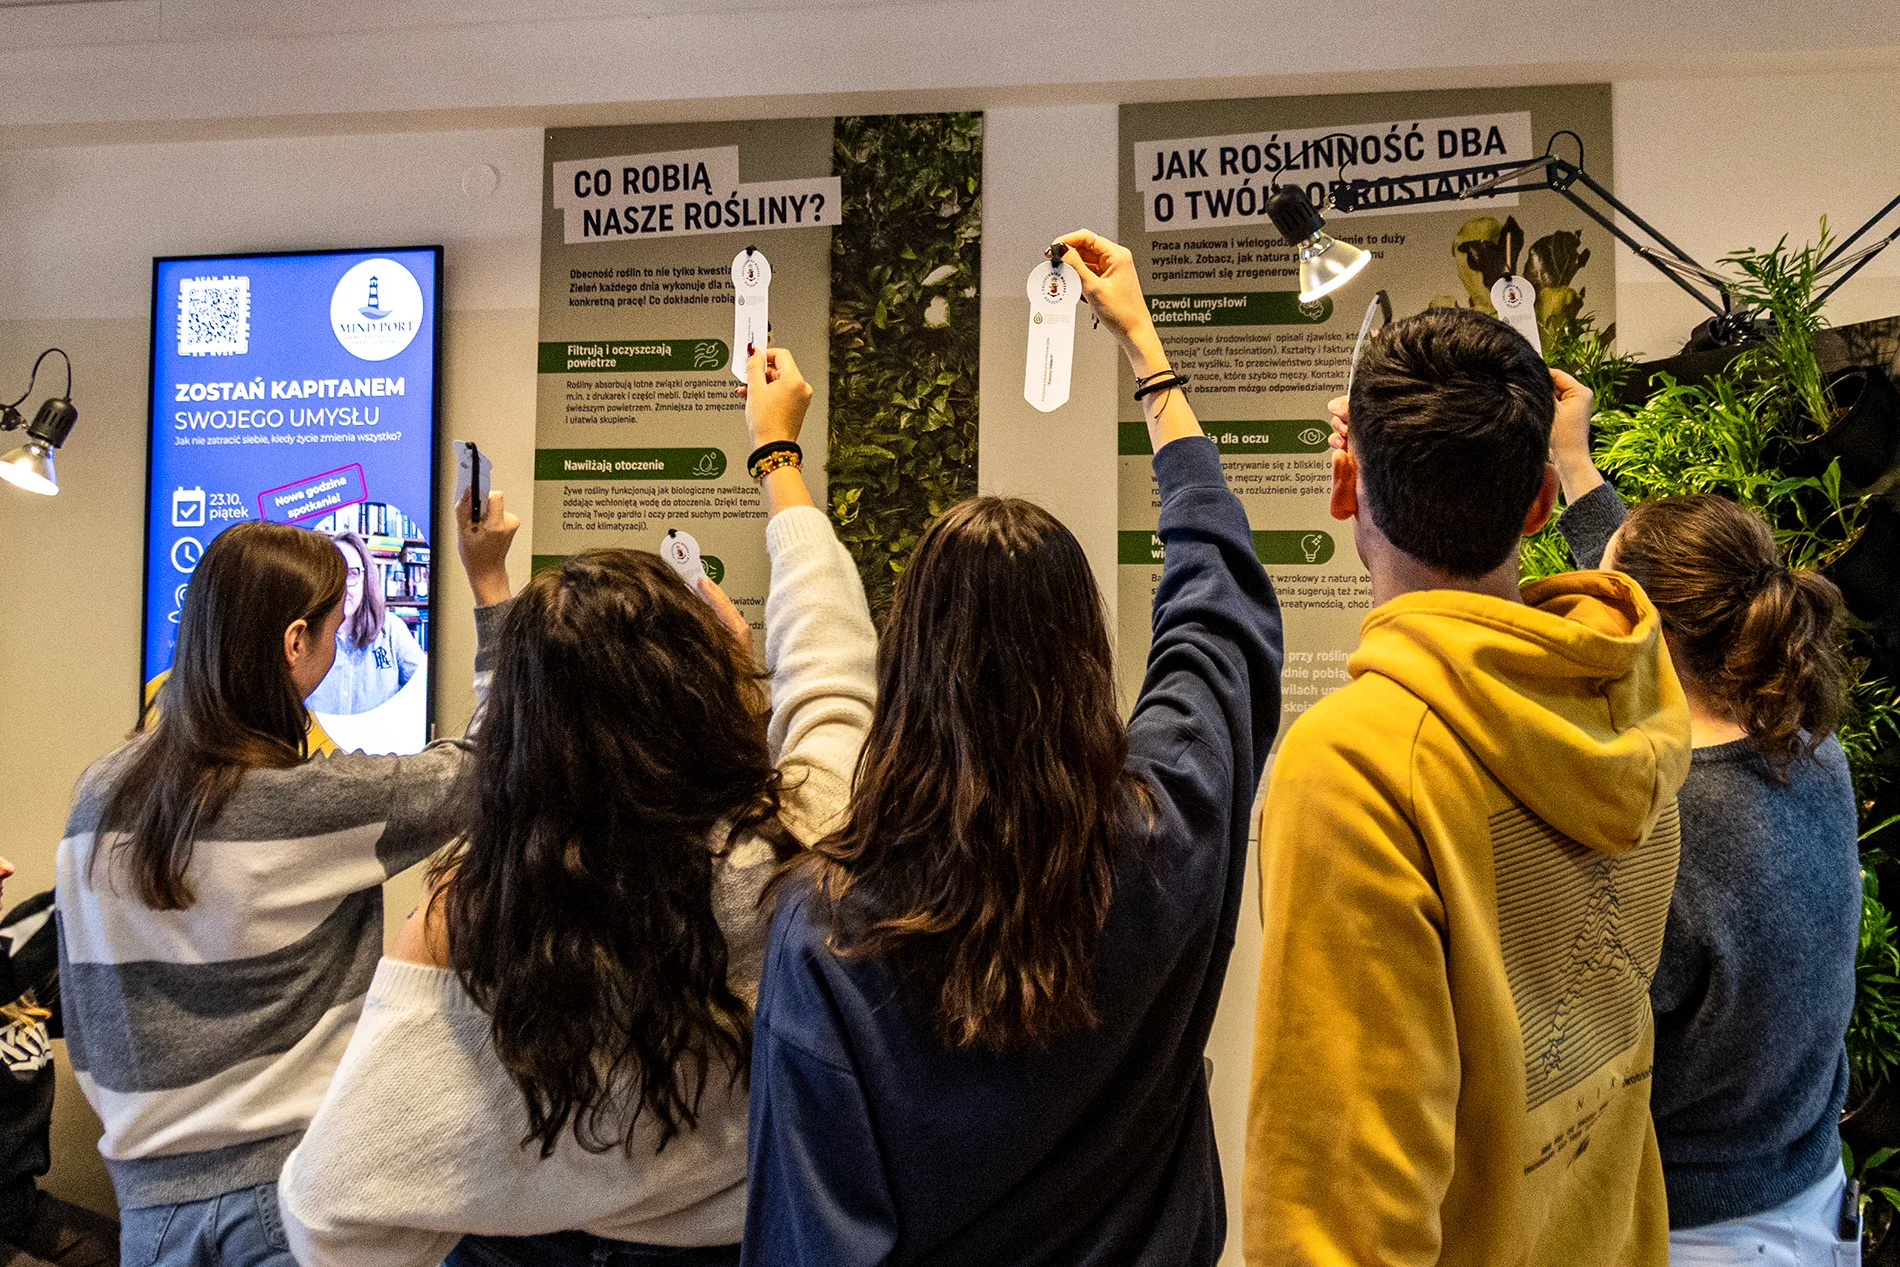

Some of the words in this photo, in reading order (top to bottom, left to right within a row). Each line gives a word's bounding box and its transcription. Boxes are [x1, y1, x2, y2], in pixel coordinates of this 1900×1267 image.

[1151, 150, 1209, 181] JAK
[1220, 123, 1425, 176] ROŚLINNOŚĆ
[1437, 126, 1507, 159] DBA
[574, 170, 611, 198] CO
[623, 162, 712, 195] ROBIĄ
[1154, 193, 1174, 222] O
[1185, 181, 1270, 220] TWÓJ
[583, 205, 673, 236] NASZE
[685, 191, 825, 230] ROŚLINY?
[1152, 241, 1180, 251] Praca
[1183, 241, 1227, 249] naukowa
[1231, 239, 1234, 248] i
[1367, 235, 1377, 244] to
[1381, 234, 1405, 246] duży
[1152, 255, 1192, 265] wysiłek.
[1196, 254, 1234, 265] Zobacz,
[1237, 253, 1253, 263] jak
[1256, 254, 1289, 262] natura
[570, 269, 614, 279] Obecność
[616, 268, 640, 277] roślin
[644, 269, 653, 277] to
[656, 268, 669, 276] nie
[673, 267, 695, 278] tylko
[1152, 269, 1215, 280] organizmowi
[1218, 268, 1233, 279] się
[1236, 268, 1300, 277] zregenerowa
[570, 283, 597, 292] Zieleń
[600, 283, 636, 292] każdego
[640, 283, 659, 291] dnia
[662, 281, 705, 292] wykonuje
[708, 280, 722, 289] dla
[569, 298, 615, 307] konkretną
[618, 296, 646, 307] pracę!
[649, 296, 660, 304] Co
[663, 295, 708, 303] dokładnie
[1151, 298, 1190, 309] Pozwól
[1194, 297, 1247, 308] umysłowi
[1151, 311, 1211, 323] odetchnąć
[340, 323, 376, 333] MIND
[380, 321, 414, 331] PORT
[1215, 334, 1271, 344] środowiskowi
[1276, 334, 1304, 343] opisali
[1306, 333, 1344, 343] zjawisko,
[568, 345, 603, 357] Filtrują
[606, 345, 610, 355] i
[612, 344, 671, 356] oczyszczają
[1203, 345, 1224, 357] (soft
[1226, 345, 1279, 356] fascination).
[1282, 344, 1315, 355] Kształty
[1318, 344, 1320, 353] i
[1323, 343, 1354, 354] faktury
[567, 358, 616, 370] powietrze
[1181, 359, 1195, 368] bez
[1199, 358, 1232, 369] wysiłku.
[1234, 358, 1244, 367] To
[1247, 357, 1312, 368] przeciwieństwo
[1194, 372, 1221, 381] nauce,
[1224, 371, 1246, 380] które
[1249, 370, 1278, 380] szybko
[1280, 371, 1308, 380] męczy.
[1311, 368, 1344, 378] Kontakt
[175, 377, 265, 401] ZOSTAŃ
[271, 377, 405, 399] KAPITANEM
[567, 381, 592, 390] Rośliny
[595, 381, 632, 389] absorbują
[656, 380, 682, 389] związki
[685, 380, 727, 389] organiczne
[1195, 383, 1235, 392] obszarom
[1239, 383, 1266, 393] mózgu
[1269, 382, 1344, 393] odpowiedzialnym
[593, 392, 626, 400] drukarek
[632, 391, 655, 400] części
[683, 391, 705, 400] Dzięki
[567, 404, 605, 412] świeższym
[607, 404, 653, 412] powietrzem.
[655, 403, 692, 411] Zmniejsza
[706, 403, 746, 412] zmęczenie
[174, 410, 283, 430] SWOJEGO
[290, 407, 380, 427] UMYSŁU
[600, 416, 637, 424] skupienie.
[174, 437, 190, 446] Jak
[192, 437, 205, 445] nie
[207, 436, 241, 445] zatracić
[242, 435, 270, 445] siebie,
[272, 435, 295, 445] kiedy
[297, 434, 318, 445] życie
[320, 434, 355, 442] zmienia
[358, 432, 402, 443] wszystko?
[1222, 434, 1238, 444] dla
[1242, 435, 1269, 444] oczu
[564, 460, 612, 472] Nawilżają
[615, 460, 665, 470] otoczenie
[1272, 460, 1284, 470] się
[1294, 460, 1323, 470] bliskiej
[1235, 474, 1263, 483] męczy
[1265, 473, 1292, 481] wzrok.
[275, 489, 305, 507] Nowa
[307, 476, 346, 497] godzina
[564, 487, 583, 496] Żywe
[585, 487, 609, 496] rośliny
[611, 486, 655, 496] funkcjonują
[657, 486, 668, 495] jak
[672, 486, 715, 496] biologiczne
[717, 486, 761, 495] nawilżacze,
[1246, 486, 1297, 494] rozluźnienie
[1300, 485, 1325, 495] gałek
[210, 493, 241, 506] 23.10.
[563, 499, 593, 508] oddając
[595, 498, 637, 508] wchłoniętą
[640, 498, 659, 508] wodę
[662, 498, 671, 506] do
[715, 498, 737, 508] Dzięki
[210, 507, 249, 521] piątek
[287, 493, 341, 519] spotkania!
[563, 510, 591, 520] chronią
[594, 510, 614, 519] Twoje
[617, 510, 641, 520] gardło
[644, 510, 646, 518] i
[648, 512, 665, 520] oczy
[668, 510, 688, 519] przed
[691, 510, 720, 520] suchym
[723, 510, 768, 519] powietrzem
[562, 522, 584, 531] (m.in.
[598, 522, 648, 532] klimatyzacji).
[1277, 574, 1318, 584] wzrokowy
[1328, 574, 1357, 584] naturą
[1298, 587, 1335, 597] sugerują
[1338, 586, 1351, 596] też
[1281, 600, 1345, 609] kreatywnością,
[1348, 599, 1369, 609] choć
[1288, 652, 1313, 663] przy
